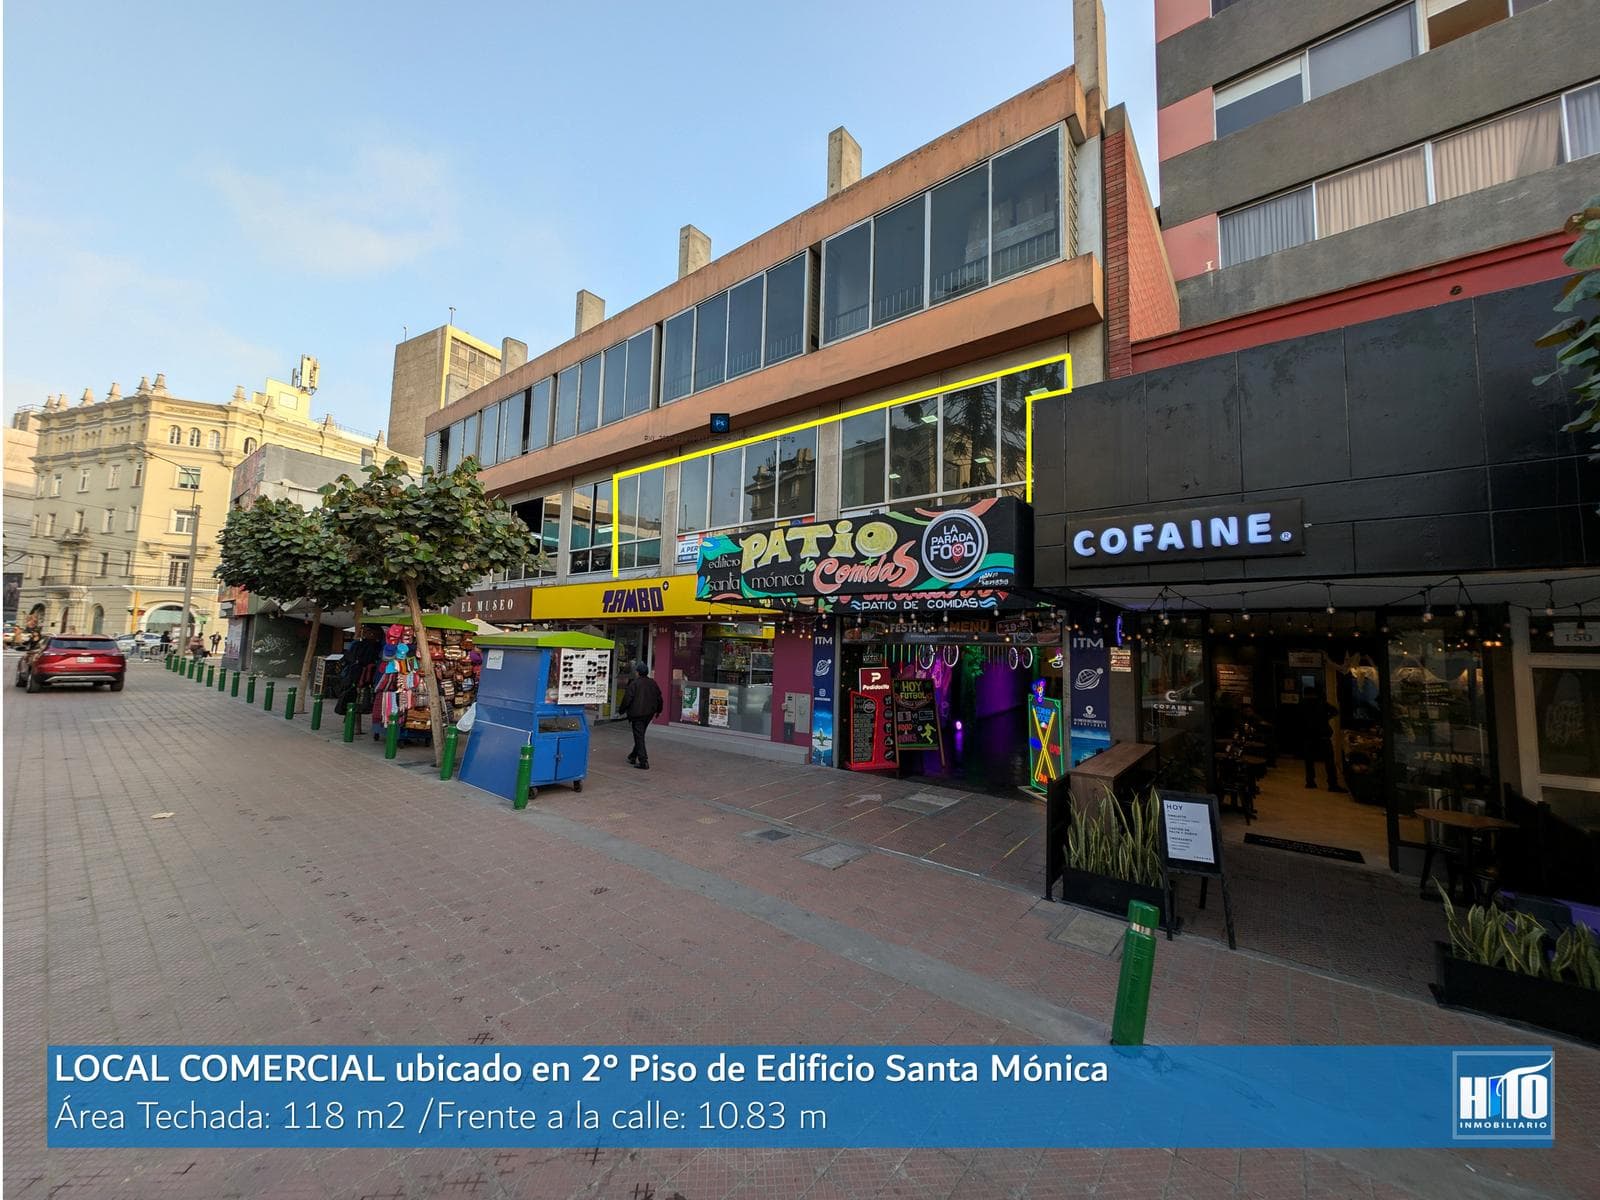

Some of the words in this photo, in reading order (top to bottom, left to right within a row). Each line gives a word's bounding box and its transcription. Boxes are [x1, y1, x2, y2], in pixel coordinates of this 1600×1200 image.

[943, 525, 958, 535] LA
[1073, 512, 1272, 557] COFAINE
[931, 532, 974, 546] PARADA
[930, 541, 977, 561] FOOD
[708, 554, 741, 569] edificio
[800, 557, 817, 573] de
[709, 571, 740, 592] santa
[752, 572, 805, 589] mónica
[461, 602, 472, 612] EL
[477, 599, 514, 612] MUSEO
[602, 587, 665, 613] TAMBO
[861, 601, 898, 611] PATIO
[903, 601, 919, 610] DE
[927, 597, 979, 610] COMIDAS
[815, 636, 833, 645] ITM
[1073, 637, 1104, 649] ITM
[901, 681, 922, 692] HOY
